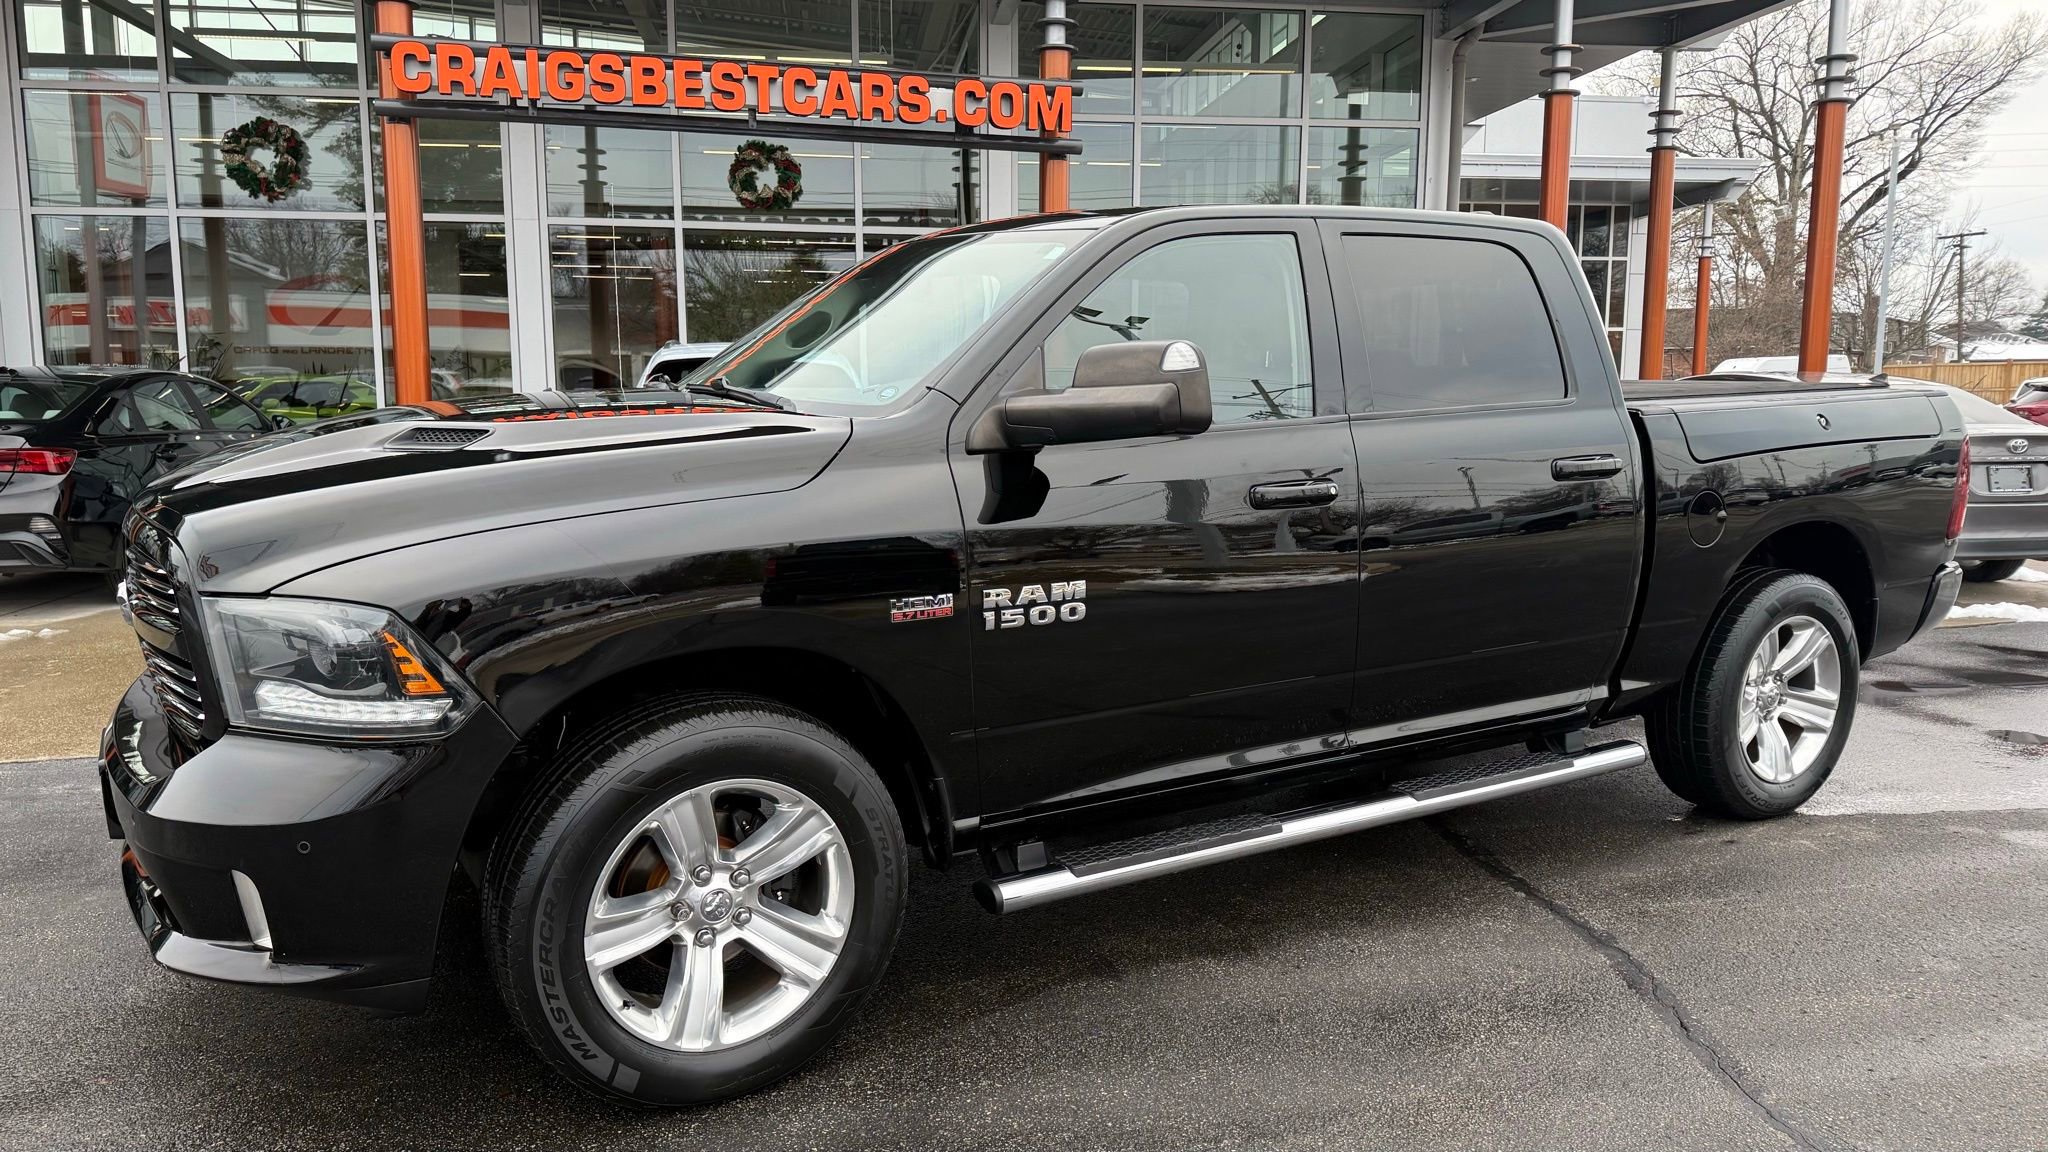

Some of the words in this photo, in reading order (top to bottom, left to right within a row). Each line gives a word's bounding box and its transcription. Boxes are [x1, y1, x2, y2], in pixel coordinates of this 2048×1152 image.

[390, 41, 1073, 132] CRAIGSBESTCARS.COM
[233, 346, 279, 354] CRAIG
[889, 593, 953, 613] HEMI
[983, 580, 1087, 609] RAM
[893, 611, 915, 621] 5.7
[916, 607, 952, 618] LITER
[983, 602, 1087, 631] 1500
[538, 870, 599, 1062] MASTERCRA
